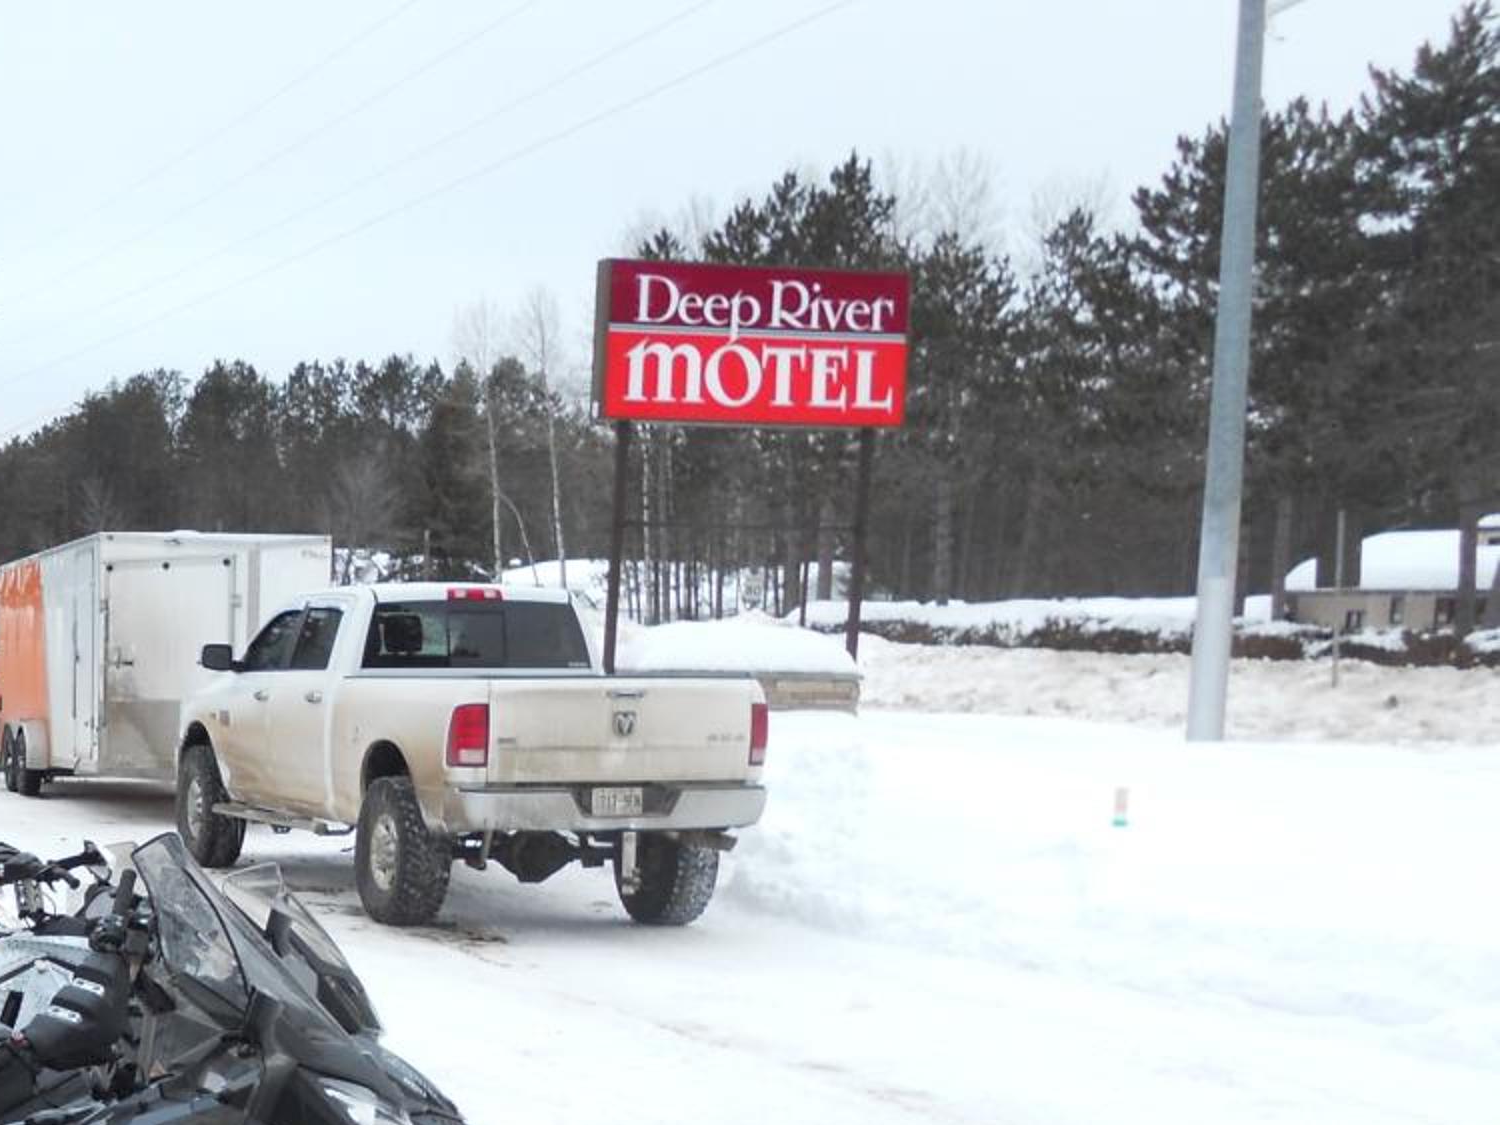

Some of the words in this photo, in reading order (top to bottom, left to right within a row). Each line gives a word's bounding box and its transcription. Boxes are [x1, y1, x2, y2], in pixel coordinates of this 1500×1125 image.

[634, 273, 761, 345] Deep
[769, 278, 895, 332] River
[624, 338, 894, 413] MOTEL
